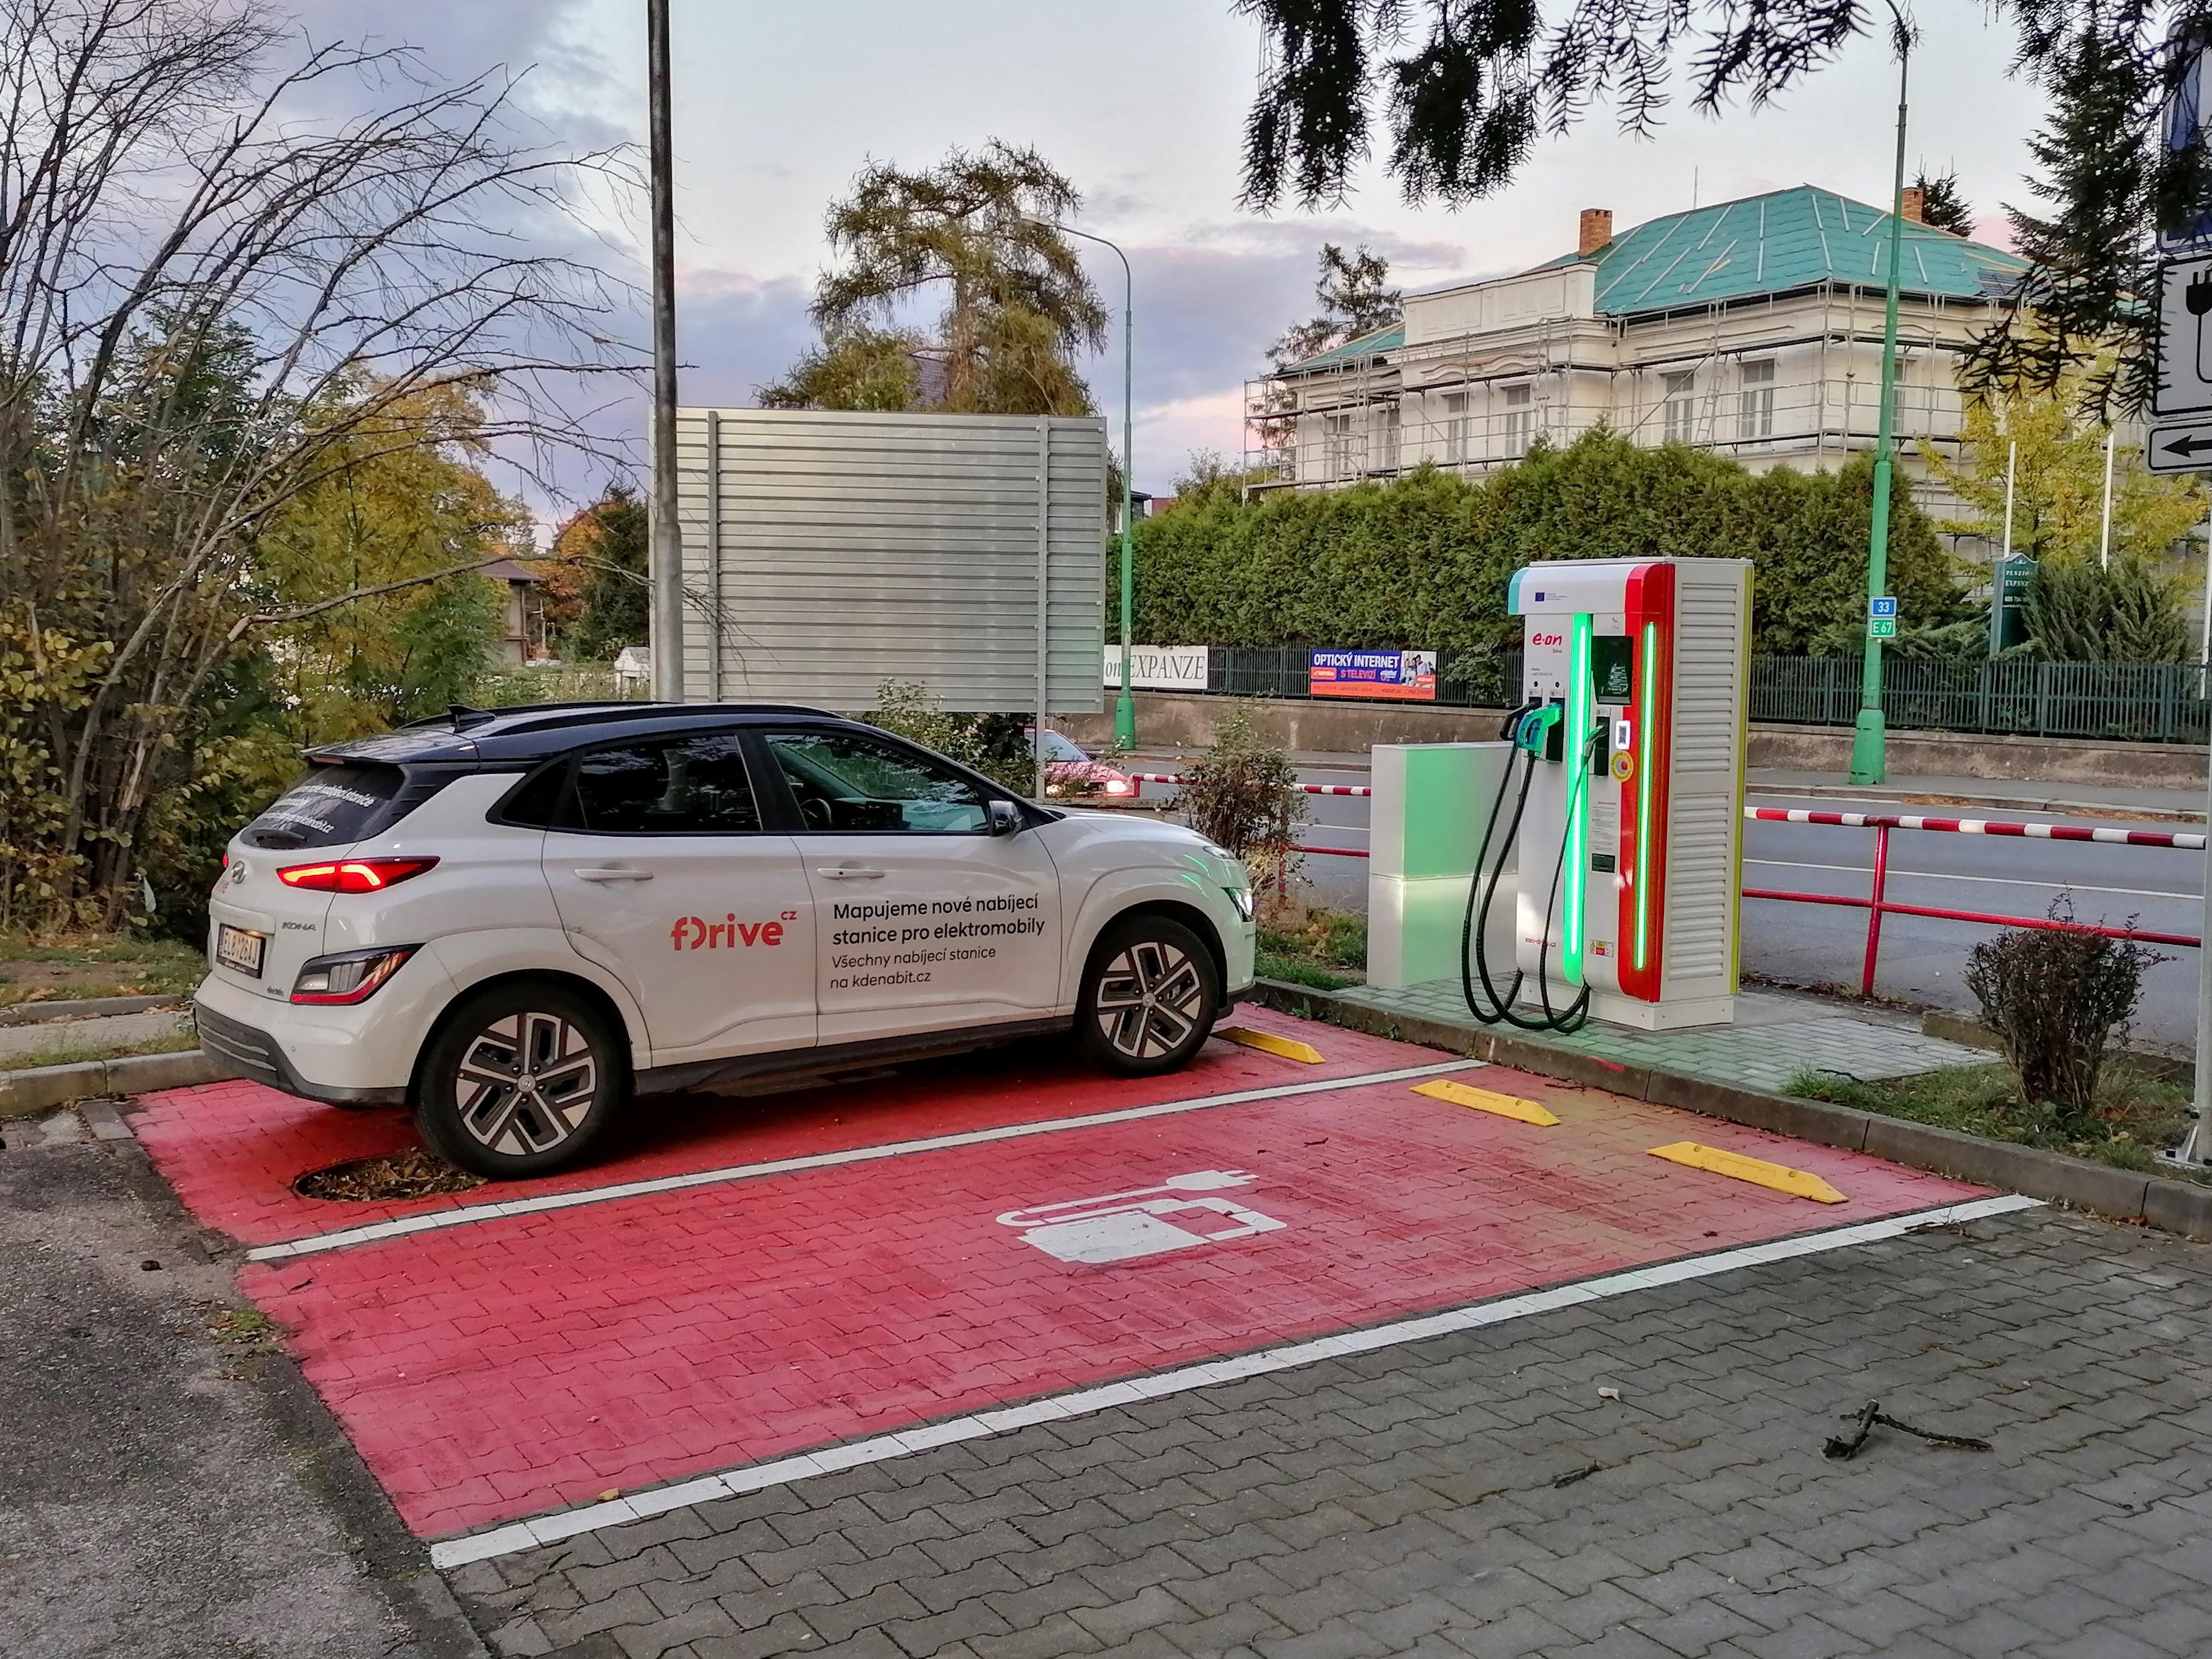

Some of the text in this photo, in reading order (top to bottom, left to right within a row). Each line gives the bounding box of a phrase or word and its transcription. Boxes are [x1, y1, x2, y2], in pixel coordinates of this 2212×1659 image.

[1878, 601, 1890, 613] 33
[1873, 622, 1892, 633] E 67
[1130, 654, 1205, 680] EXPANZE
[1314, 652, 1400, 669] OPTICKÝ INTERNET
[833, 893, 1039, 921] Mapujeme nové nabíjecí
[282, 922, 316, 931] KONA
[832, 917, 1045, 945] stanice pro elektromobily
[832, 947, 997, 969] Všechny nabíjecí stanice
[830, 971, 932, 989] na kdenabit.cz
